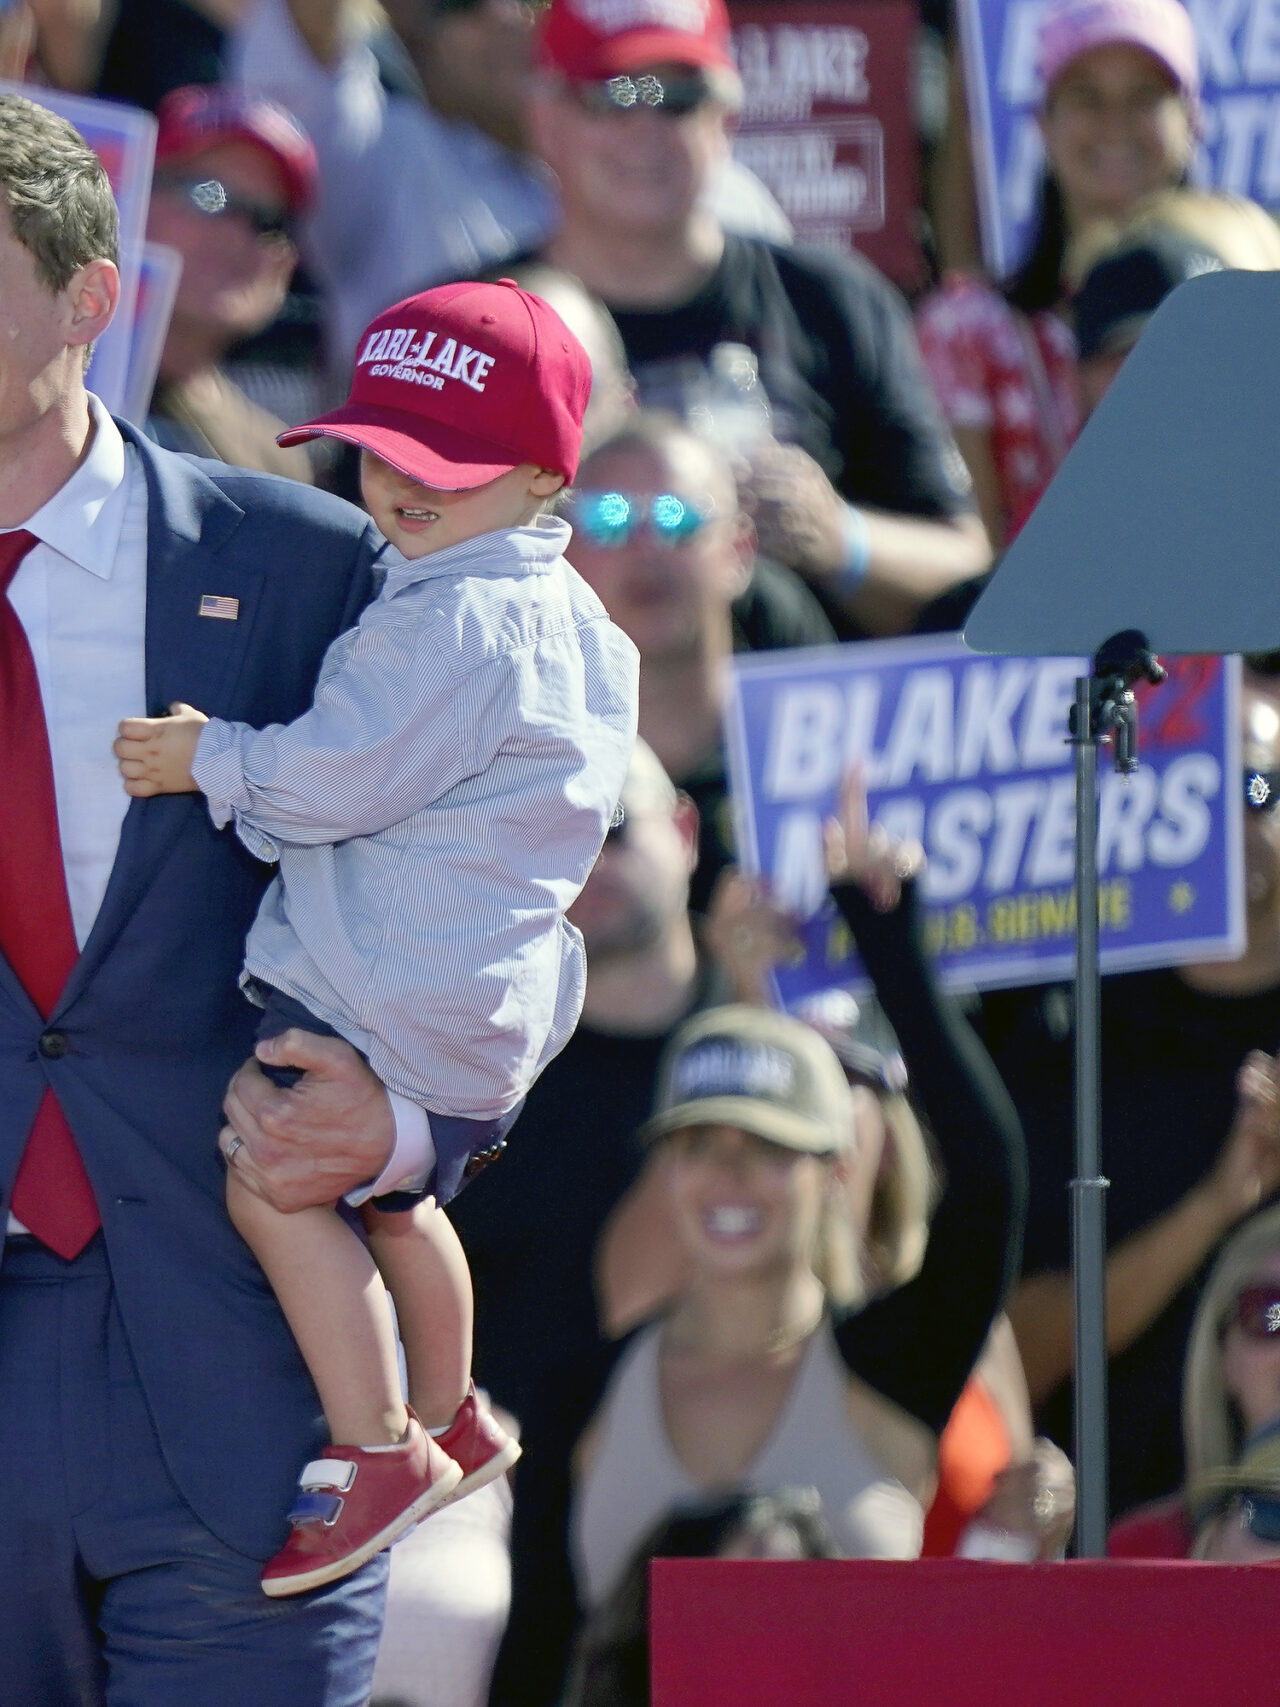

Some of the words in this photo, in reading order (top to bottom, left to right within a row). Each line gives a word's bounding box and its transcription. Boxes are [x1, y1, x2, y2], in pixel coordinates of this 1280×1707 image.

[357, 328, 418, 367] KARI
[418, 331, 496, 393] LAKE
[370, 364, 446, 391] GOVERNOR
[766, 659, 1089, 799] BLAKE
